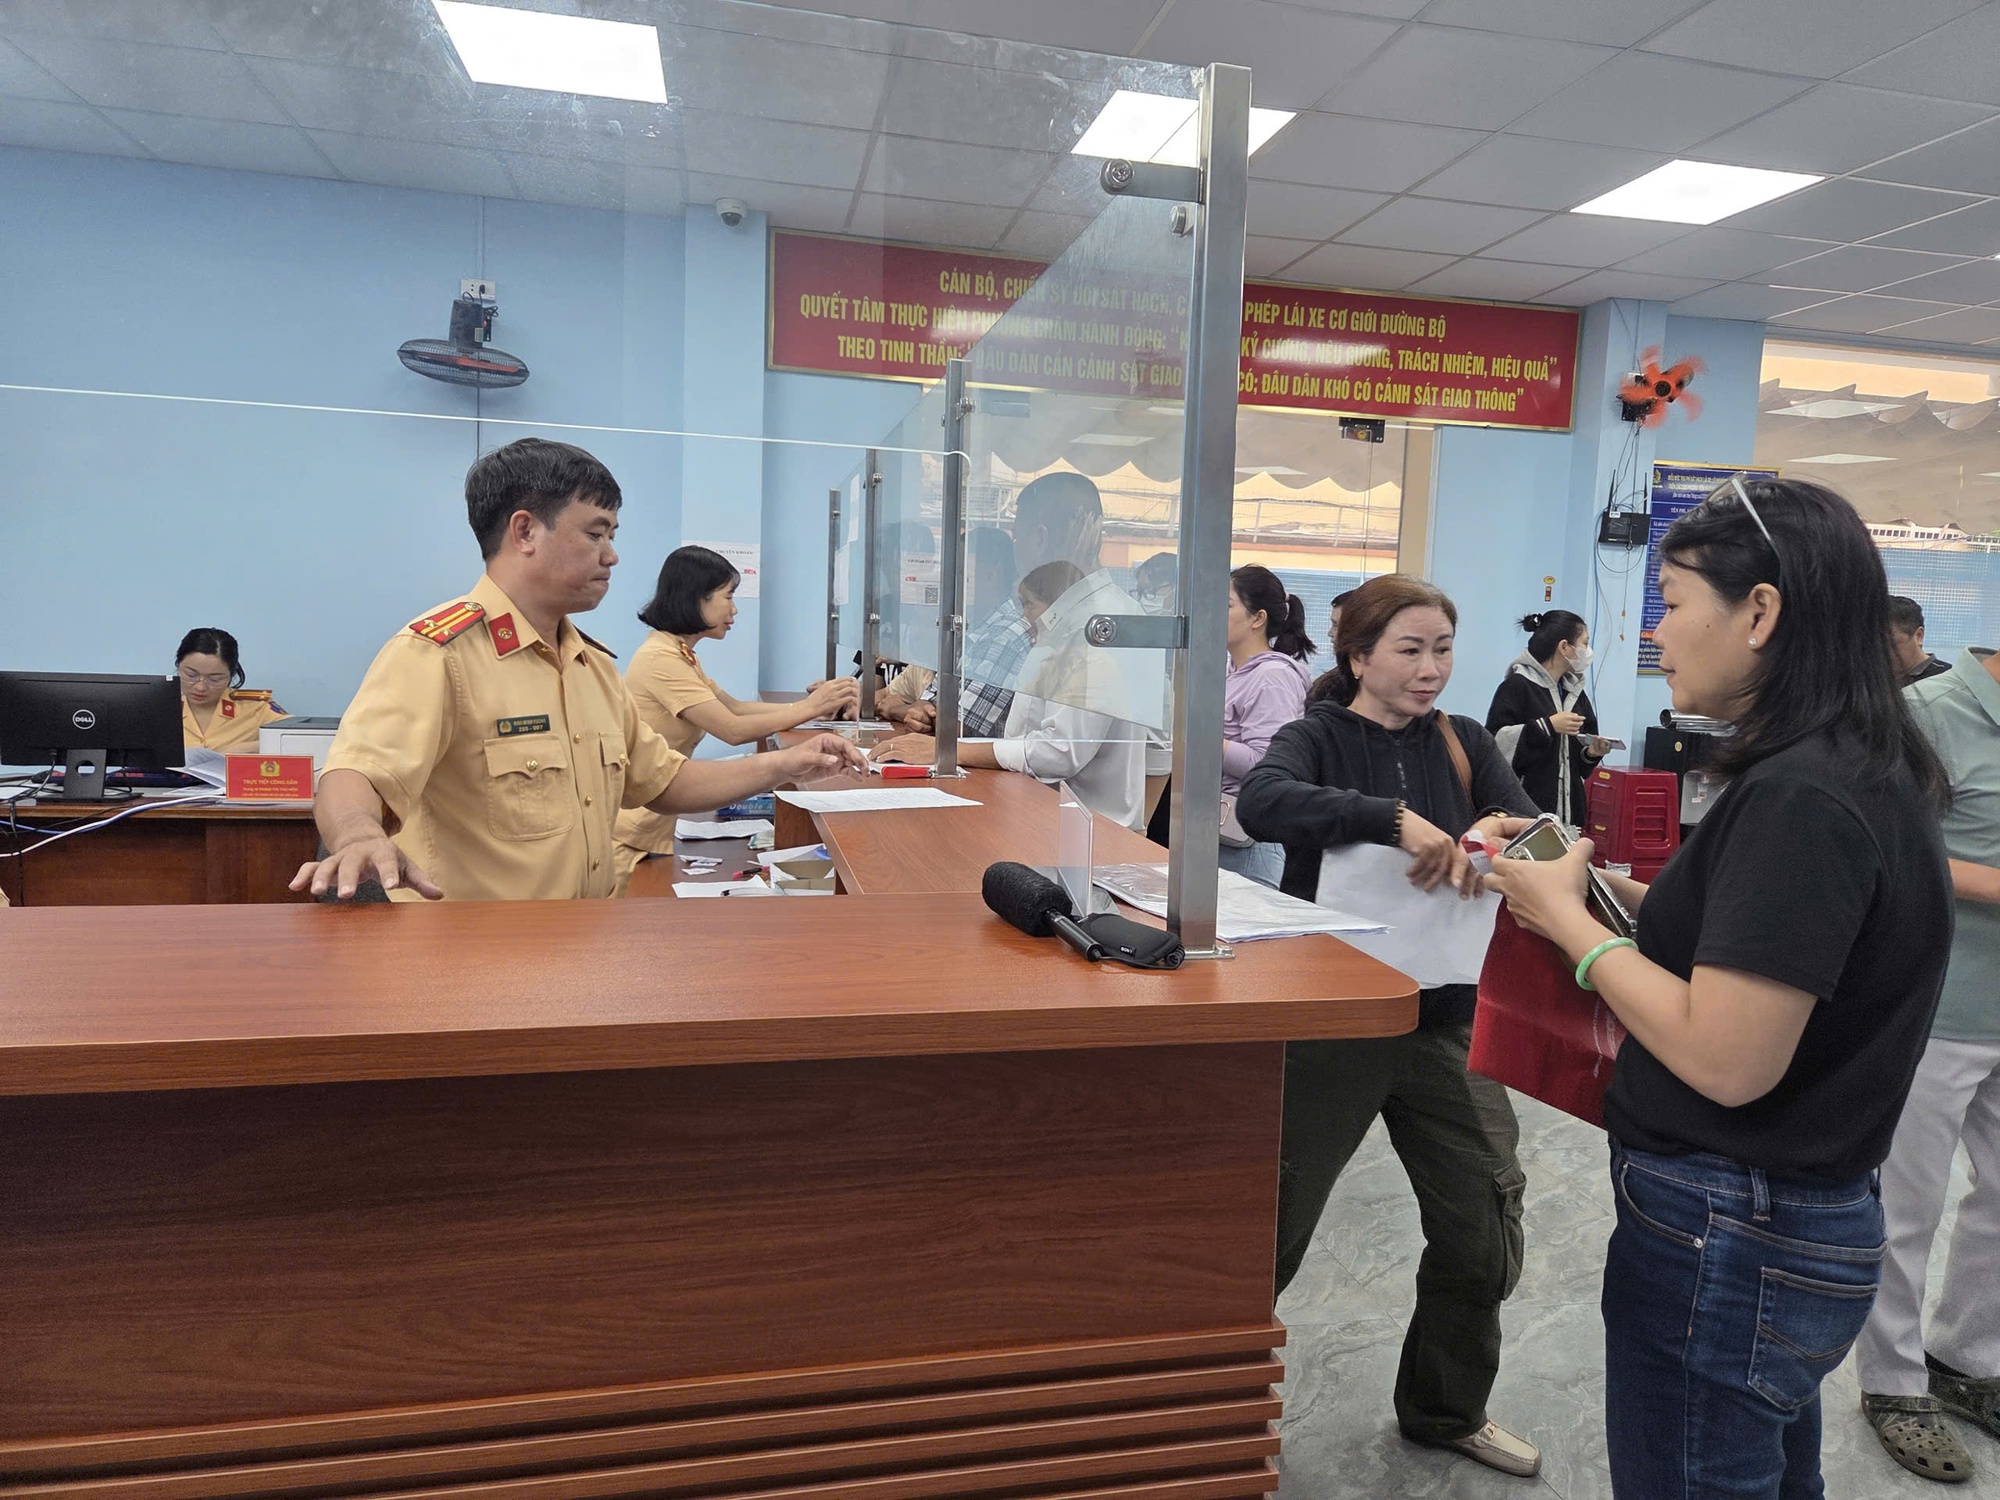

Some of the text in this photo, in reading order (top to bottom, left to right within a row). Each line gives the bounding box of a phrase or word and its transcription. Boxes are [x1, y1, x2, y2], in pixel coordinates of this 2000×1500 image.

[800, 290, 848, 320] QUYẾT
[852, 296, 885, 324] TÂM
[890, 303, 928, 331] THỰC
[932, 304, 967, 335] HIỆN
[1081, 318, 1119, 346] HÀNH
[1123, 322, 1166, 353] ĐỘNG:
[1241, 330, 1259, 358] KỶ
[1262, 337, 1311, 366] CƯƠNG,
[1315, 340, 1342, 365] NÊU
[1346, 343, 1394, 372] GƯƠNG,
[1398, 347, 1439, 372] TRÁCH
[1442, 351, 1488, 379] NHIỆM,
[1491, 354, 1521, 382] HIỆU
[940, 267, 970, 295] CÁN
[974, 271, 999, 302] BỘ,
[1244, 299, 1280, 324] PHÉP
[1284, 302, 1304, 327] LÁI
[1308, 307, 1325, 328] XE
[1329, 308, 1348, 331] CƠ
[1351, 308, 1377, 333] GIỚI
[1381, 310, 1425, 337] ĐƯỜNG
[1428, 314, 1446, 343] BỘ
[838, 335, 875, 360] THEO
[880, 339, 914, 363] TINH
[919, 338, 962, 367] THẦN:
[1078, 351, 1116, 381] CẢNH
[1120, 357, 1146, 384] SÁT
[1150, 364, 1182, 387] GIAO
[1261, 370, 1289, 396] ĐÂU
[1292, 373, 1320, 398] DÂN
[1323, 376, 1350, 400] KHÓ
[1354, 378, 1371, 402] CÓ
[1375, 376, 1411, 405] CẢNH
[1414, 382, 1439, 407] SÁT
[1441, 387, 1472, 409] GIAO
[729, 802, 763, 810] Double
